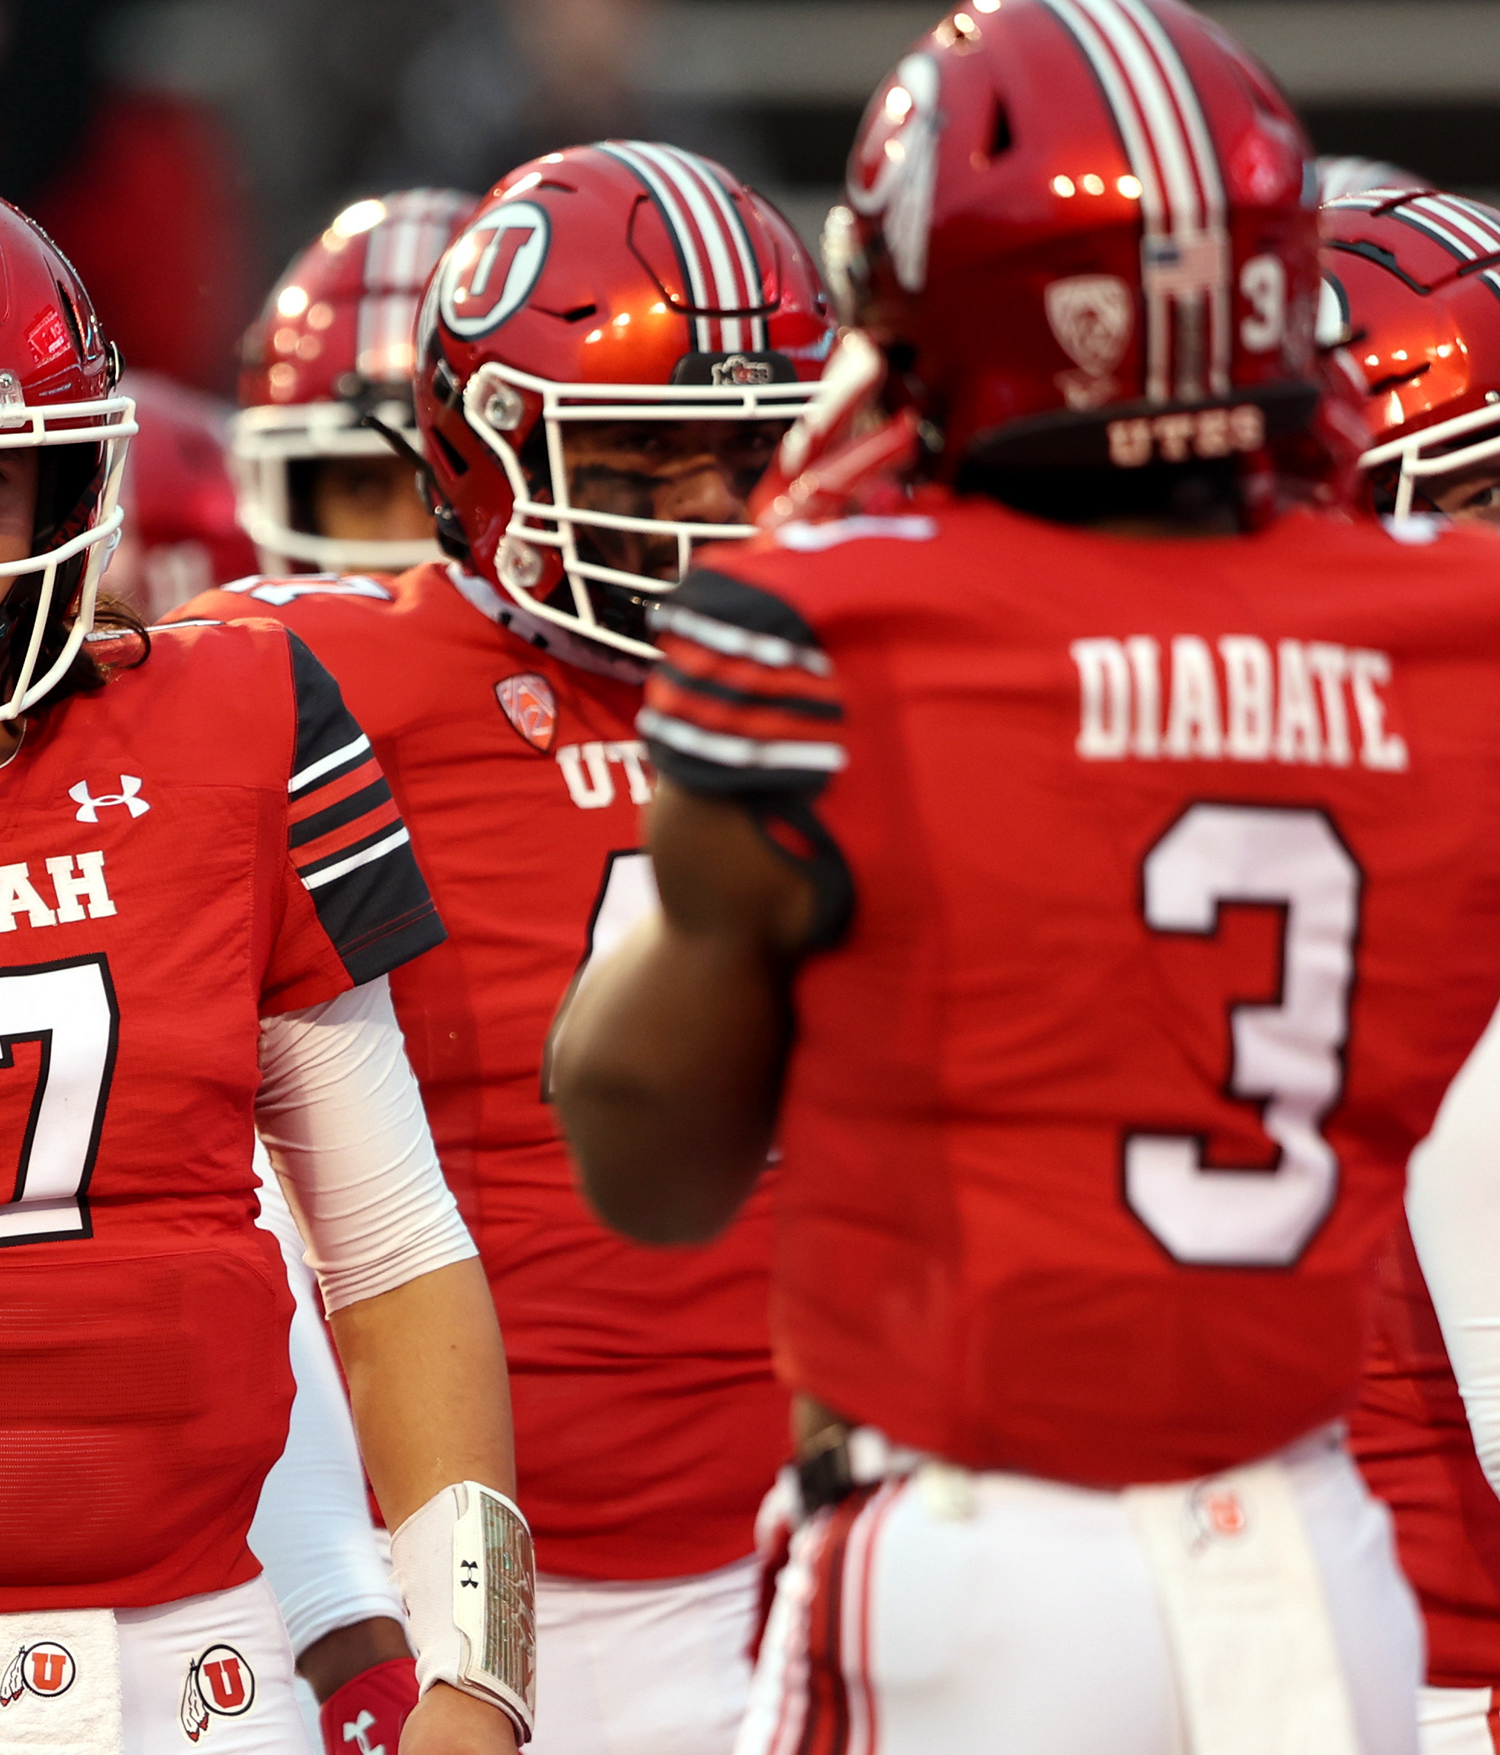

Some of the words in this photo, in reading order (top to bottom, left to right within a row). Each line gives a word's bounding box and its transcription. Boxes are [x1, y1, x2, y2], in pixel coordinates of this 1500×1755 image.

[1240, 254, 1286, 351] 3
[1106, 404, 1266, 467] UTES
[1072, 635, 1408, 771] DIABATE
[555, 740, 653, 809] UT
[1124, 802, 1362, 1267] 3
[32, 1652, 66, 1690] U
[203, 1657, 246, 1709] U
